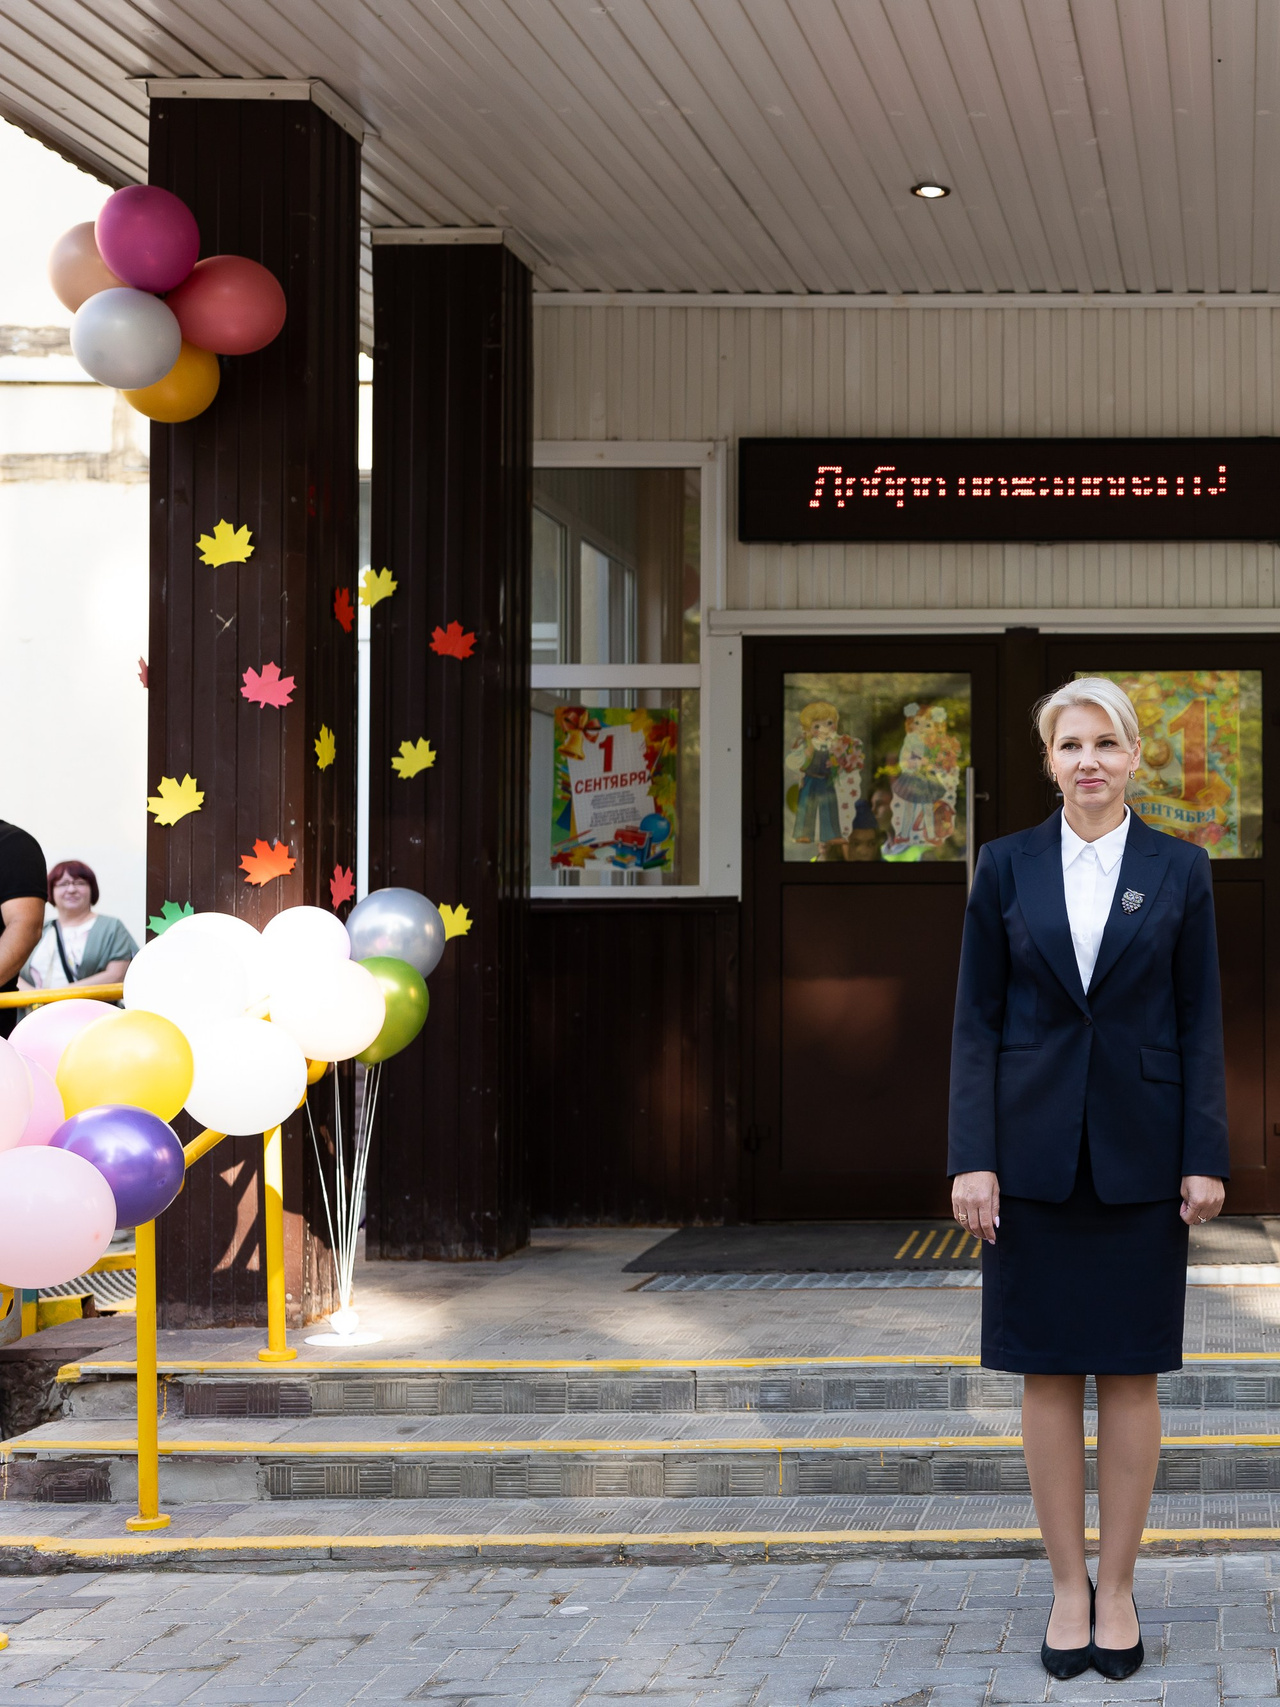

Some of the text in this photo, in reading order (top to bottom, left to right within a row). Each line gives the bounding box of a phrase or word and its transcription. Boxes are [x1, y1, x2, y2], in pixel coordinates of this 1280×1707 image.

[598, 734, 614, 773] 1
[1167, 697, 1209, 801] 1
[574, 770, 647, 795] СЕНТЯБРЯ
